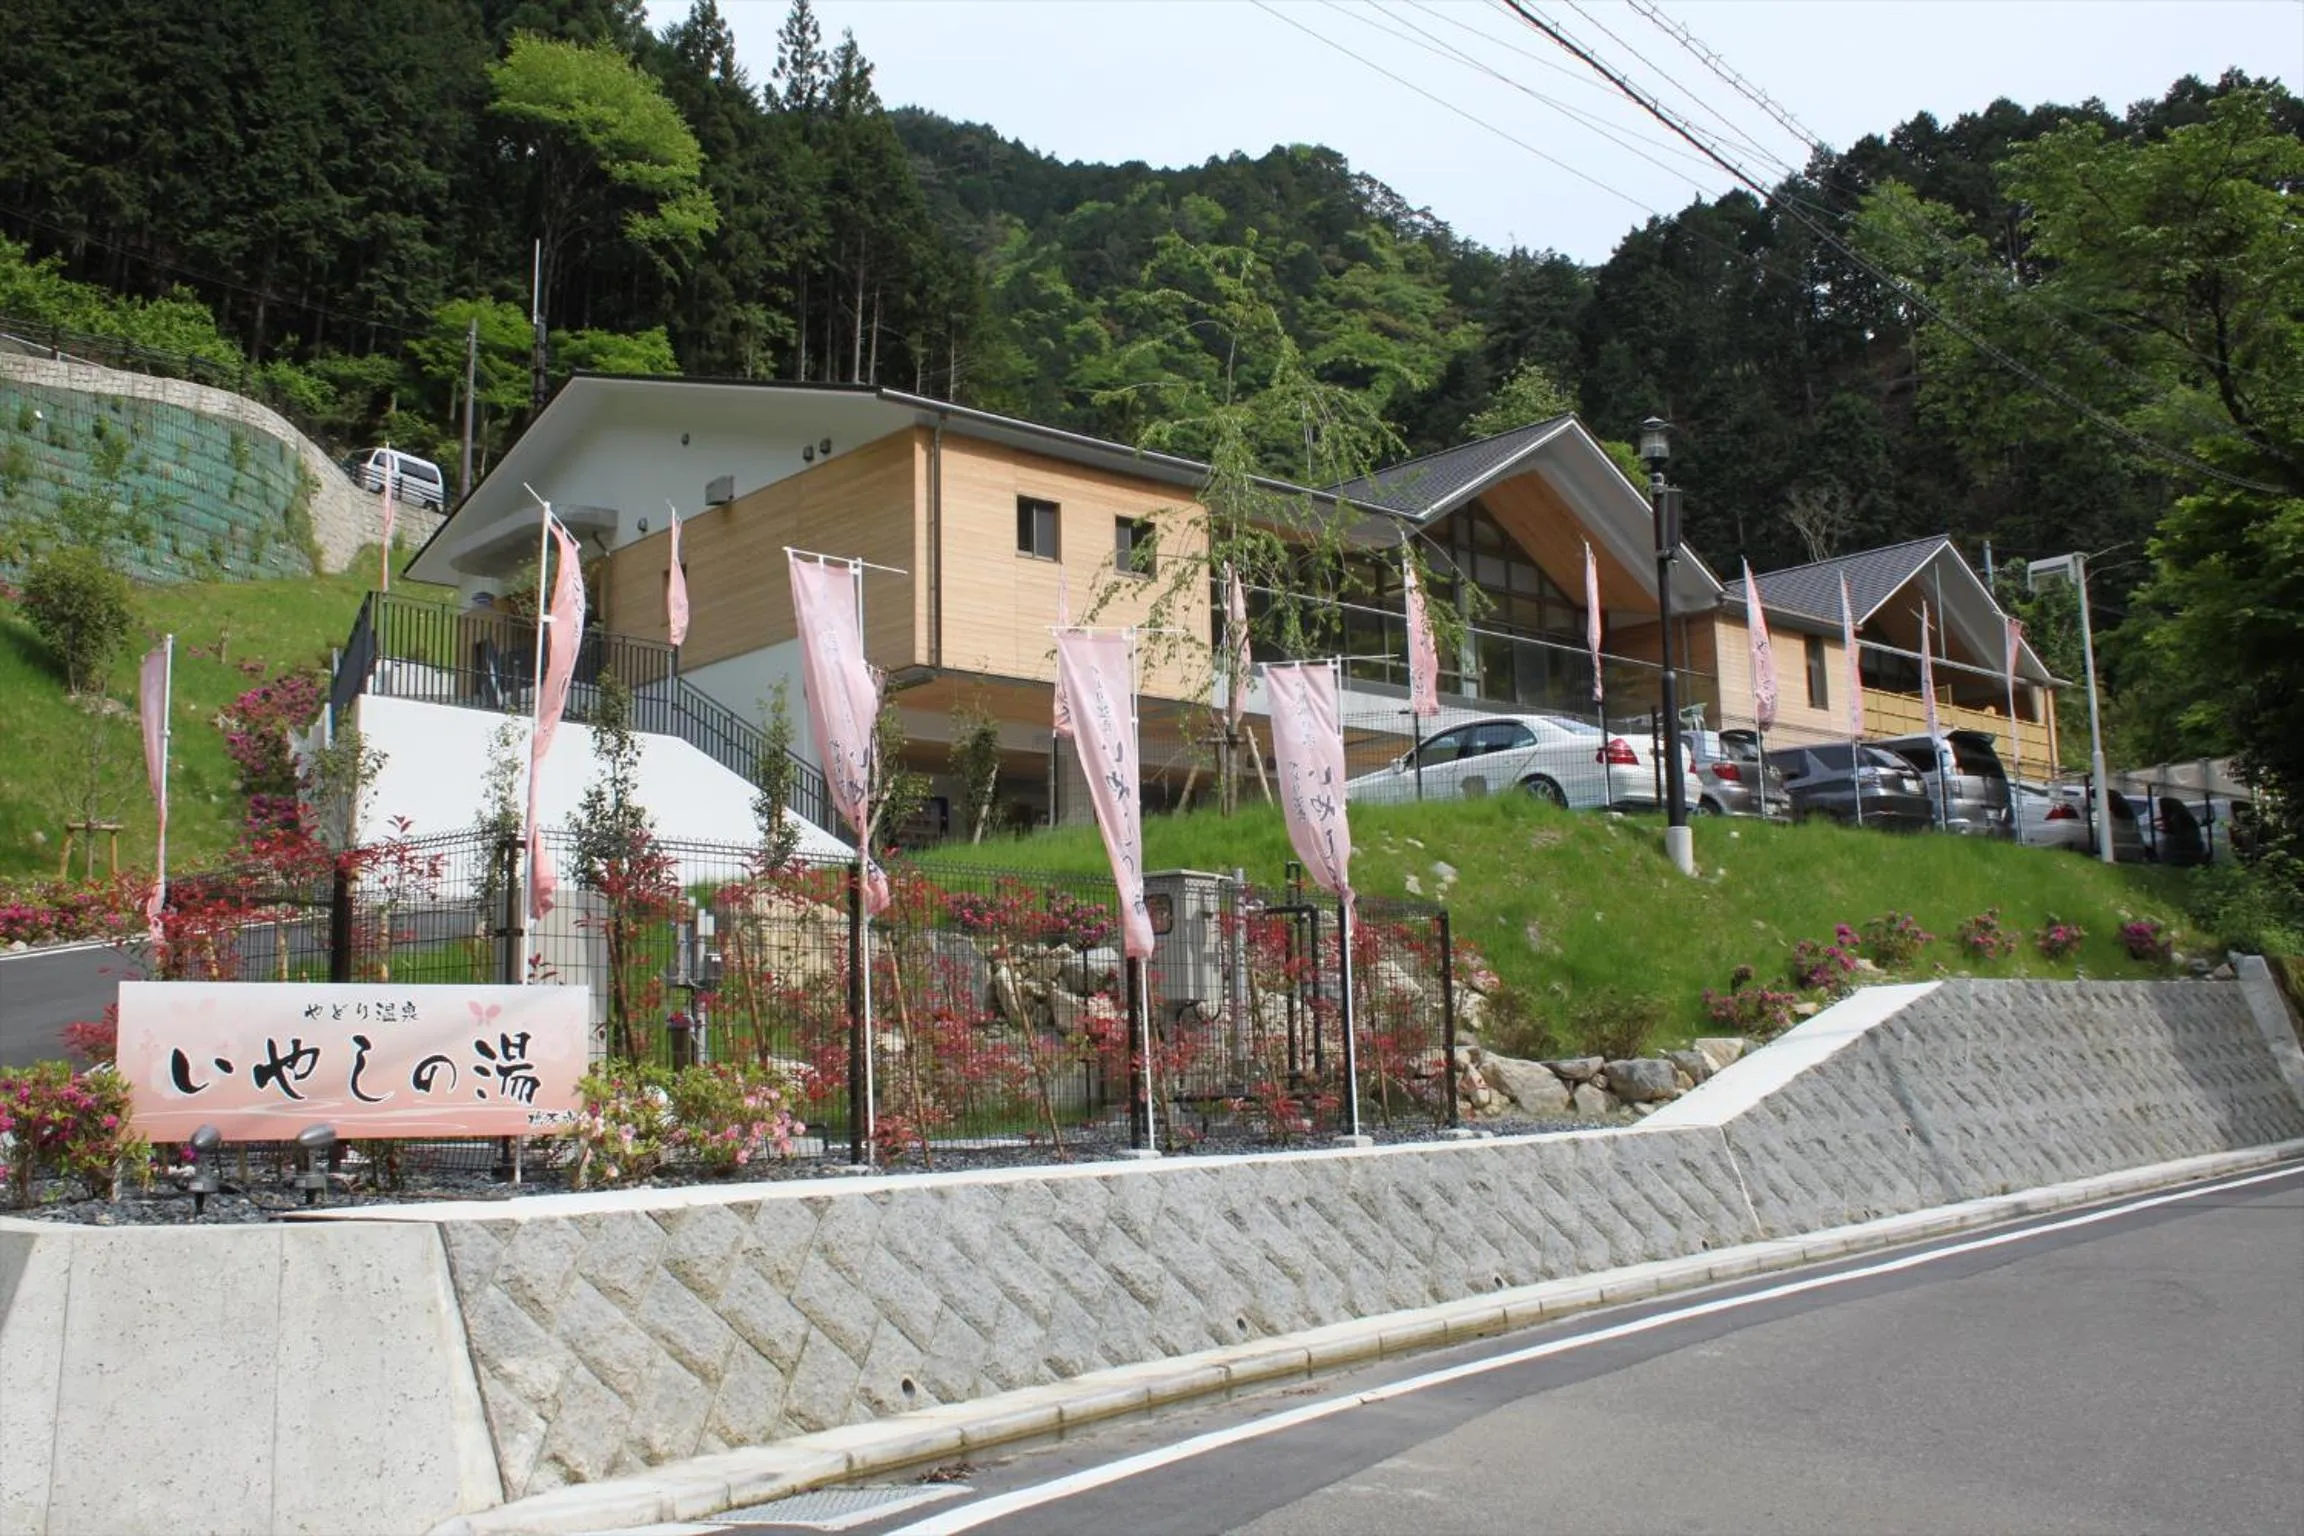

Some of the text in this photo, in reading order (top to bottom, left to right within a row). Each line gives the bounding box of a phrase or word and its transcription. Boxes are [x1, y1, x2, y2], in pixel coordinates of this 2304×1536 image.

[304, 1000, 418, 1022] やどり温泉
[171, 1034, 542, 1105] いやしの湯
